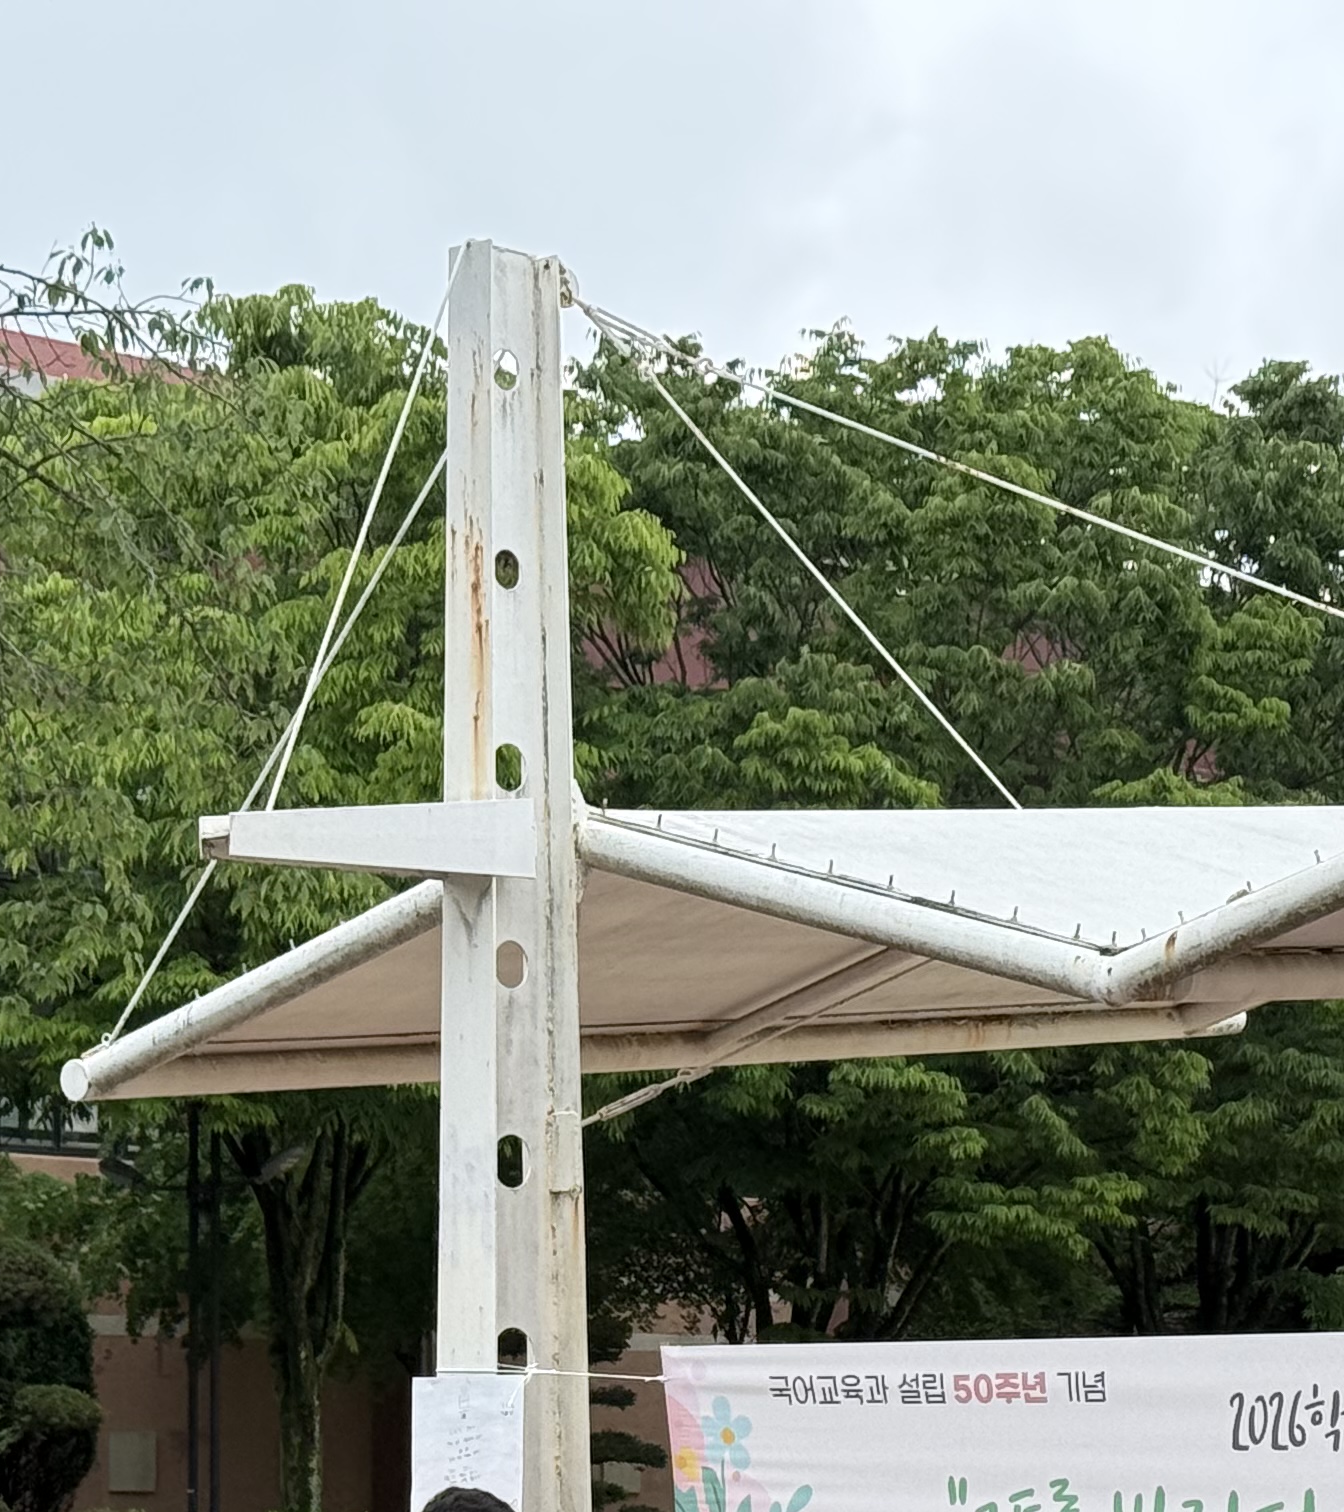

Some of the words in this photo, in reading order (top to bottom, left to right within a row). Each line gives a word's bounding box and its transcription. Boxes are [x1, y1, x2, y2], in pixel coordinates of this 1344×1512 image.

[768, 1375, 889, 1406] 국어교육과
[897, 1373, 947, 1405] 설립
[953, 1371, 1049, 1404] 50주년
[1056, 1370, 1107, 1403] 기념
